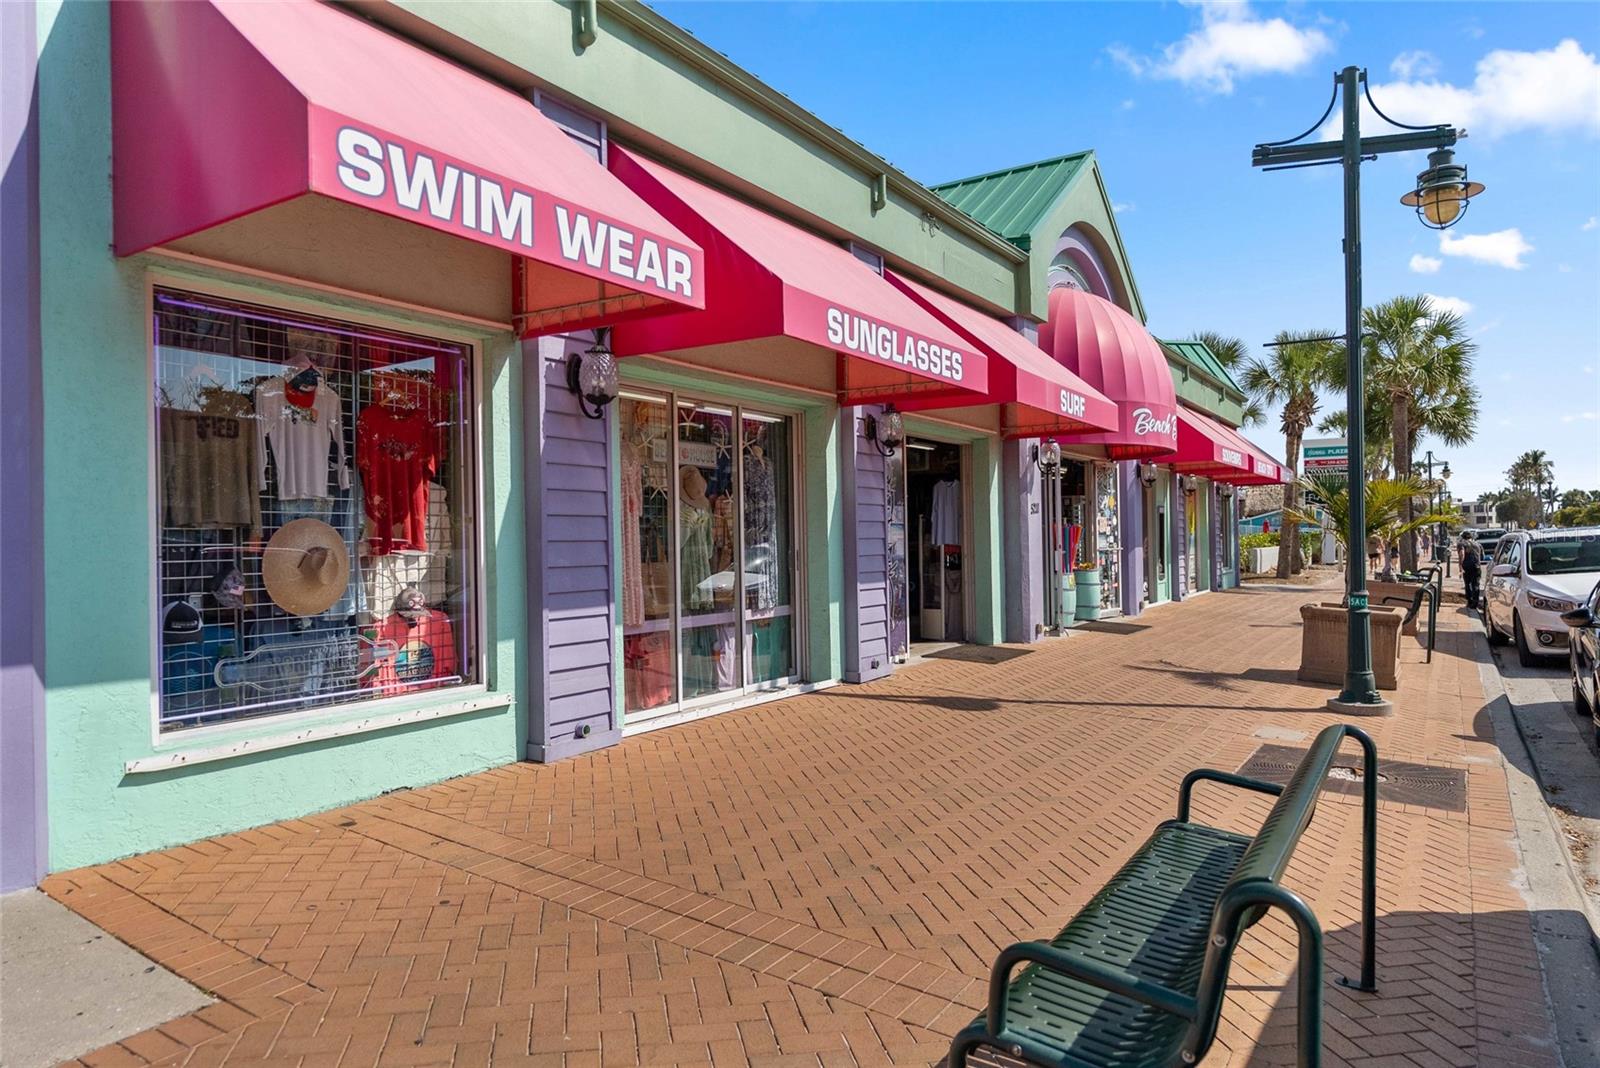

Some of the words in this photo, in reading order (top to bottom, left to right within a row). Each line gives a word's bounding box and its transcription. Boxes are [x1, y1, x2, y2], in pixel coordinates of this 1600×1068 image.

[336, 126, 534, 249] SWIM
[554, 205, 693, 298] WEAR
[827, 308, 963, 382] SUNGLASSES
[1060, 389, 1086, 418] SURF
[1133, 407, 1171, 436] Beach
